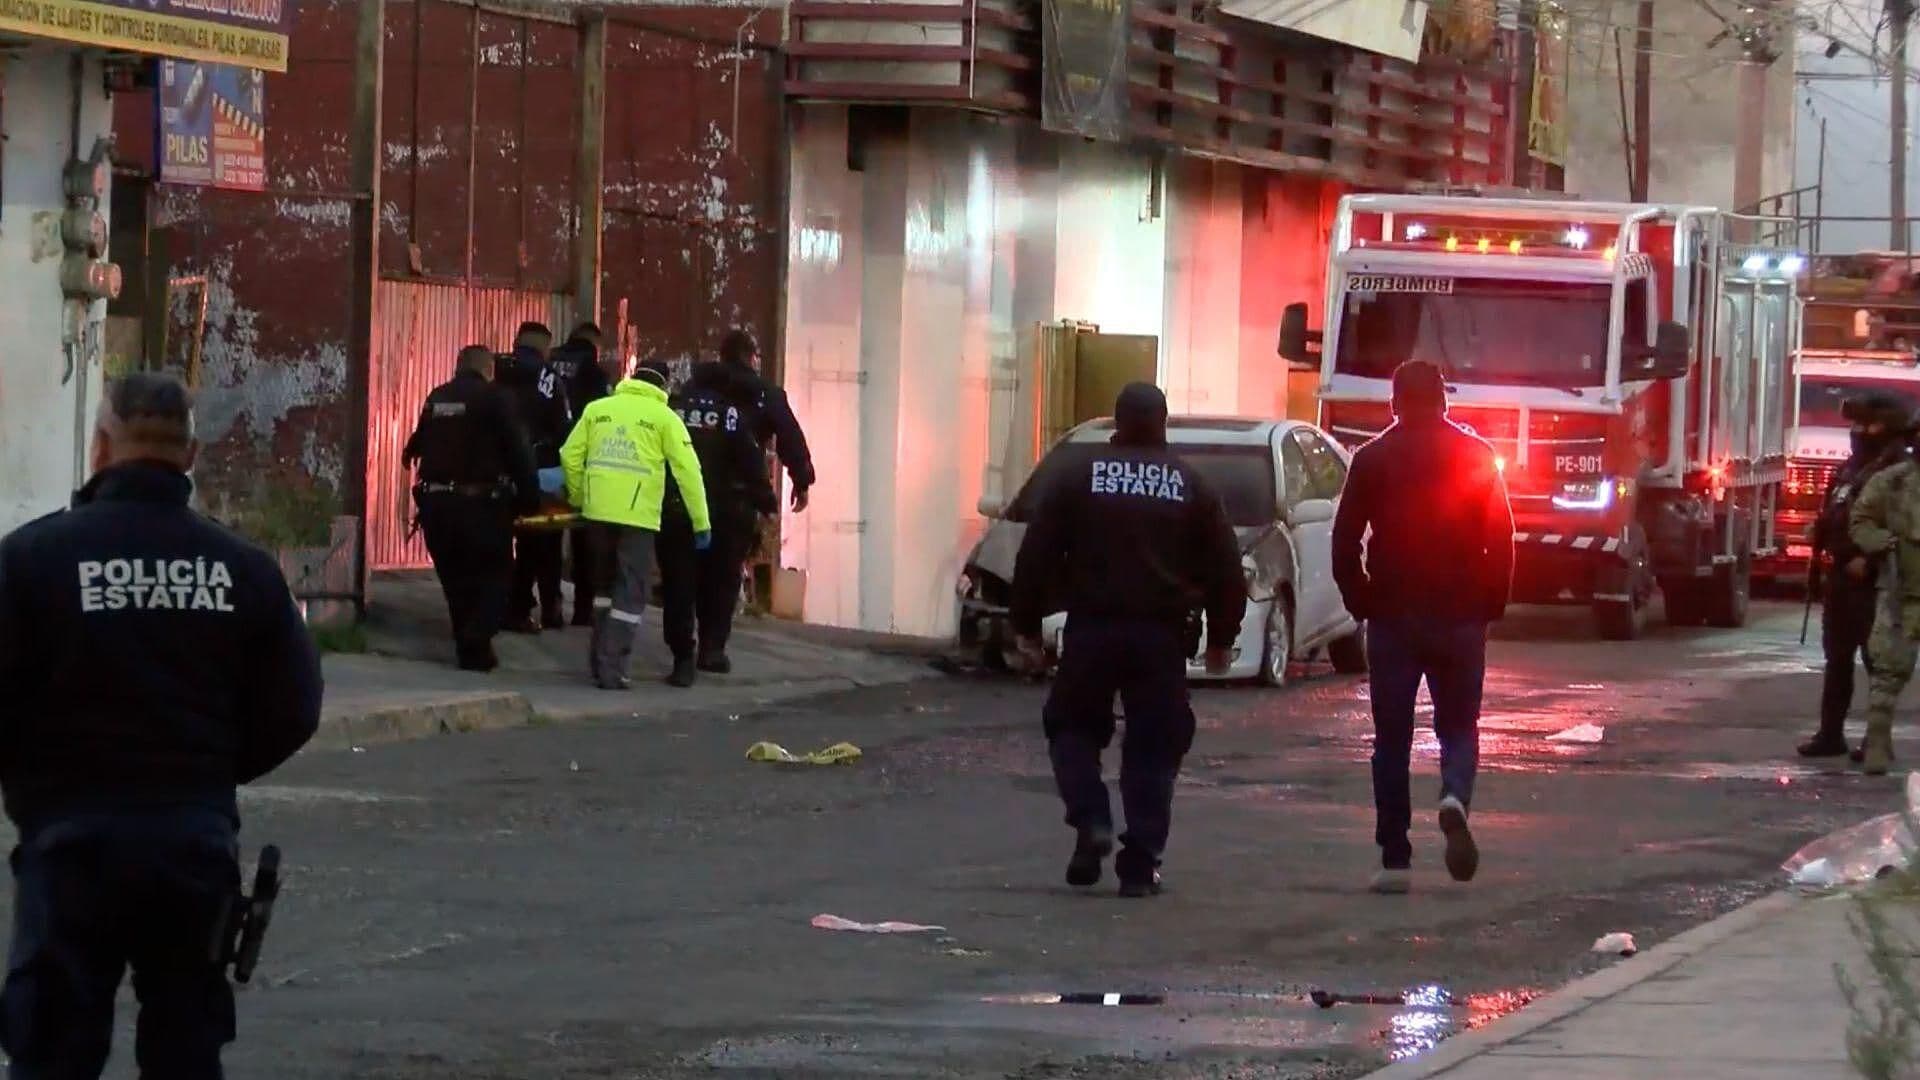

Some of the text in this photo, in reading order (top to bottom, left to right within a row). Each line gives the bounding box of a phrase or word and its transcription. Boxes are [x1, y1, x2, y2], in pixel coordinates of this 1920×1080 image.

[102, 15, 156, 43] CONTROLES
[167, 133, 208, 164] PILAS
[1555, 455, 1602, 473] PE-901
[1091, 476, 1185, 502] ESTATAL
[78, 555, 232, 588] POLICÍA
[80, 585, 235, 612] ESTATAL
